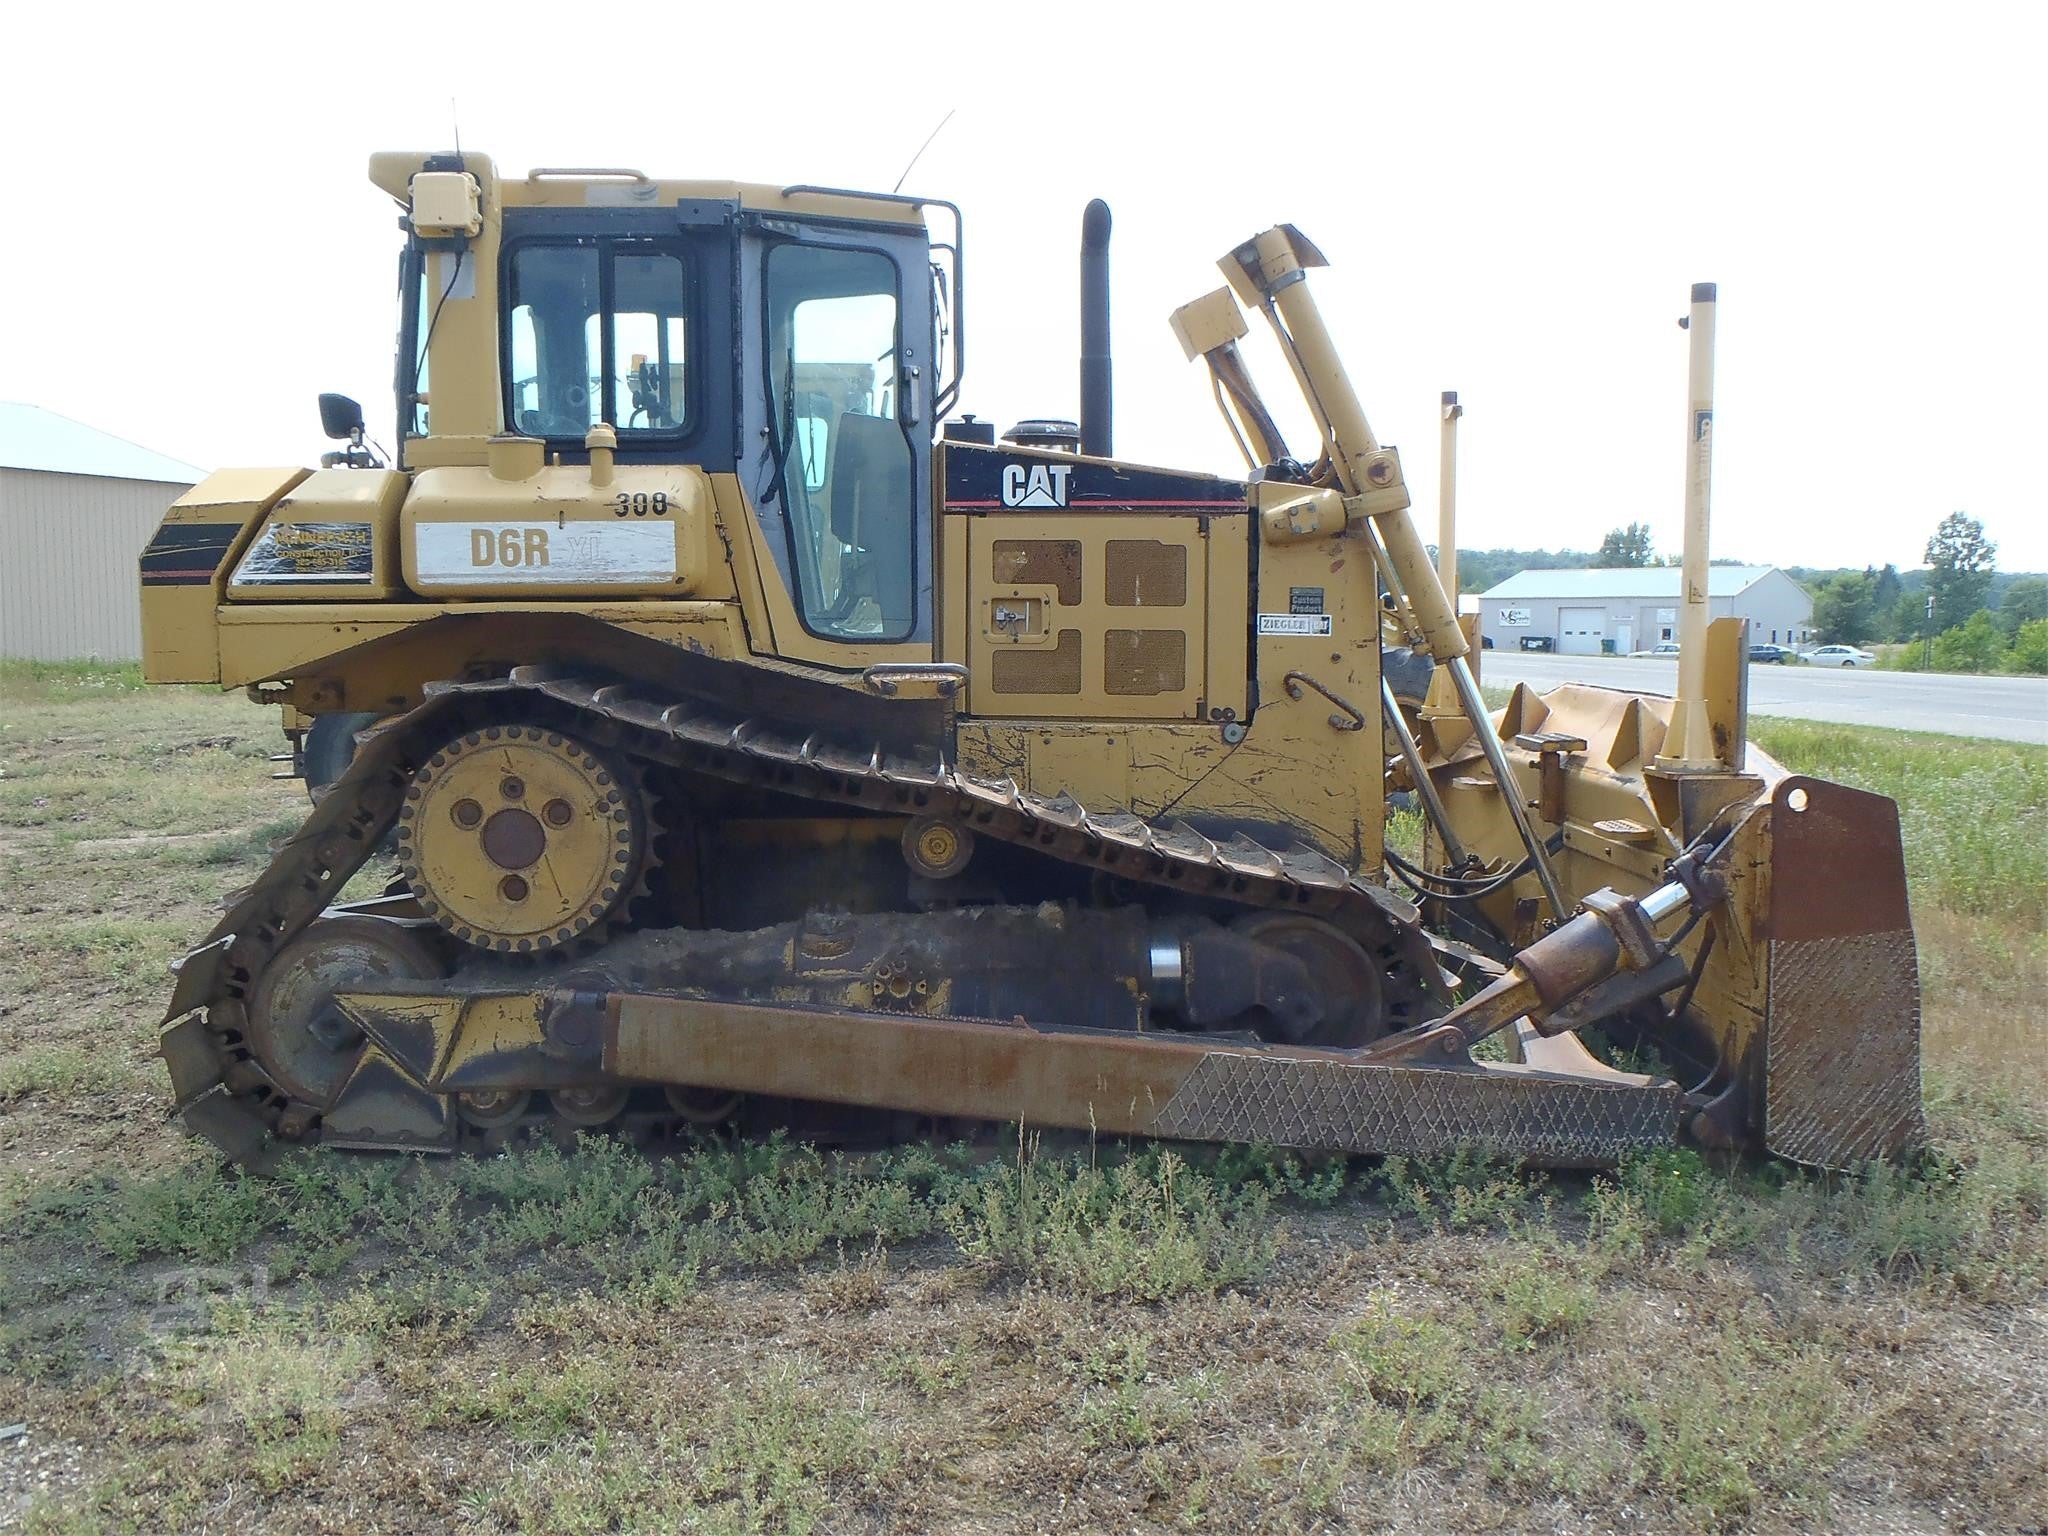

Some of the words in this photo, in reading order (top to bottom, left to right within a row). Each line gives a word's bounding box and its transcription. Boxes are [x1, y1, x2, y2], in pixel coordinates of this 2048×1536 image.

[1003, 464, 1072, 507] CAT
[614, 492, 668, 517] 308
[470, 528, 550, 567] D6R
[1291, 604, 1321, 613] Product
[1292, 596, 1321, 604] Custom
[1263, 619, 1306, 630] ZIEGLER
